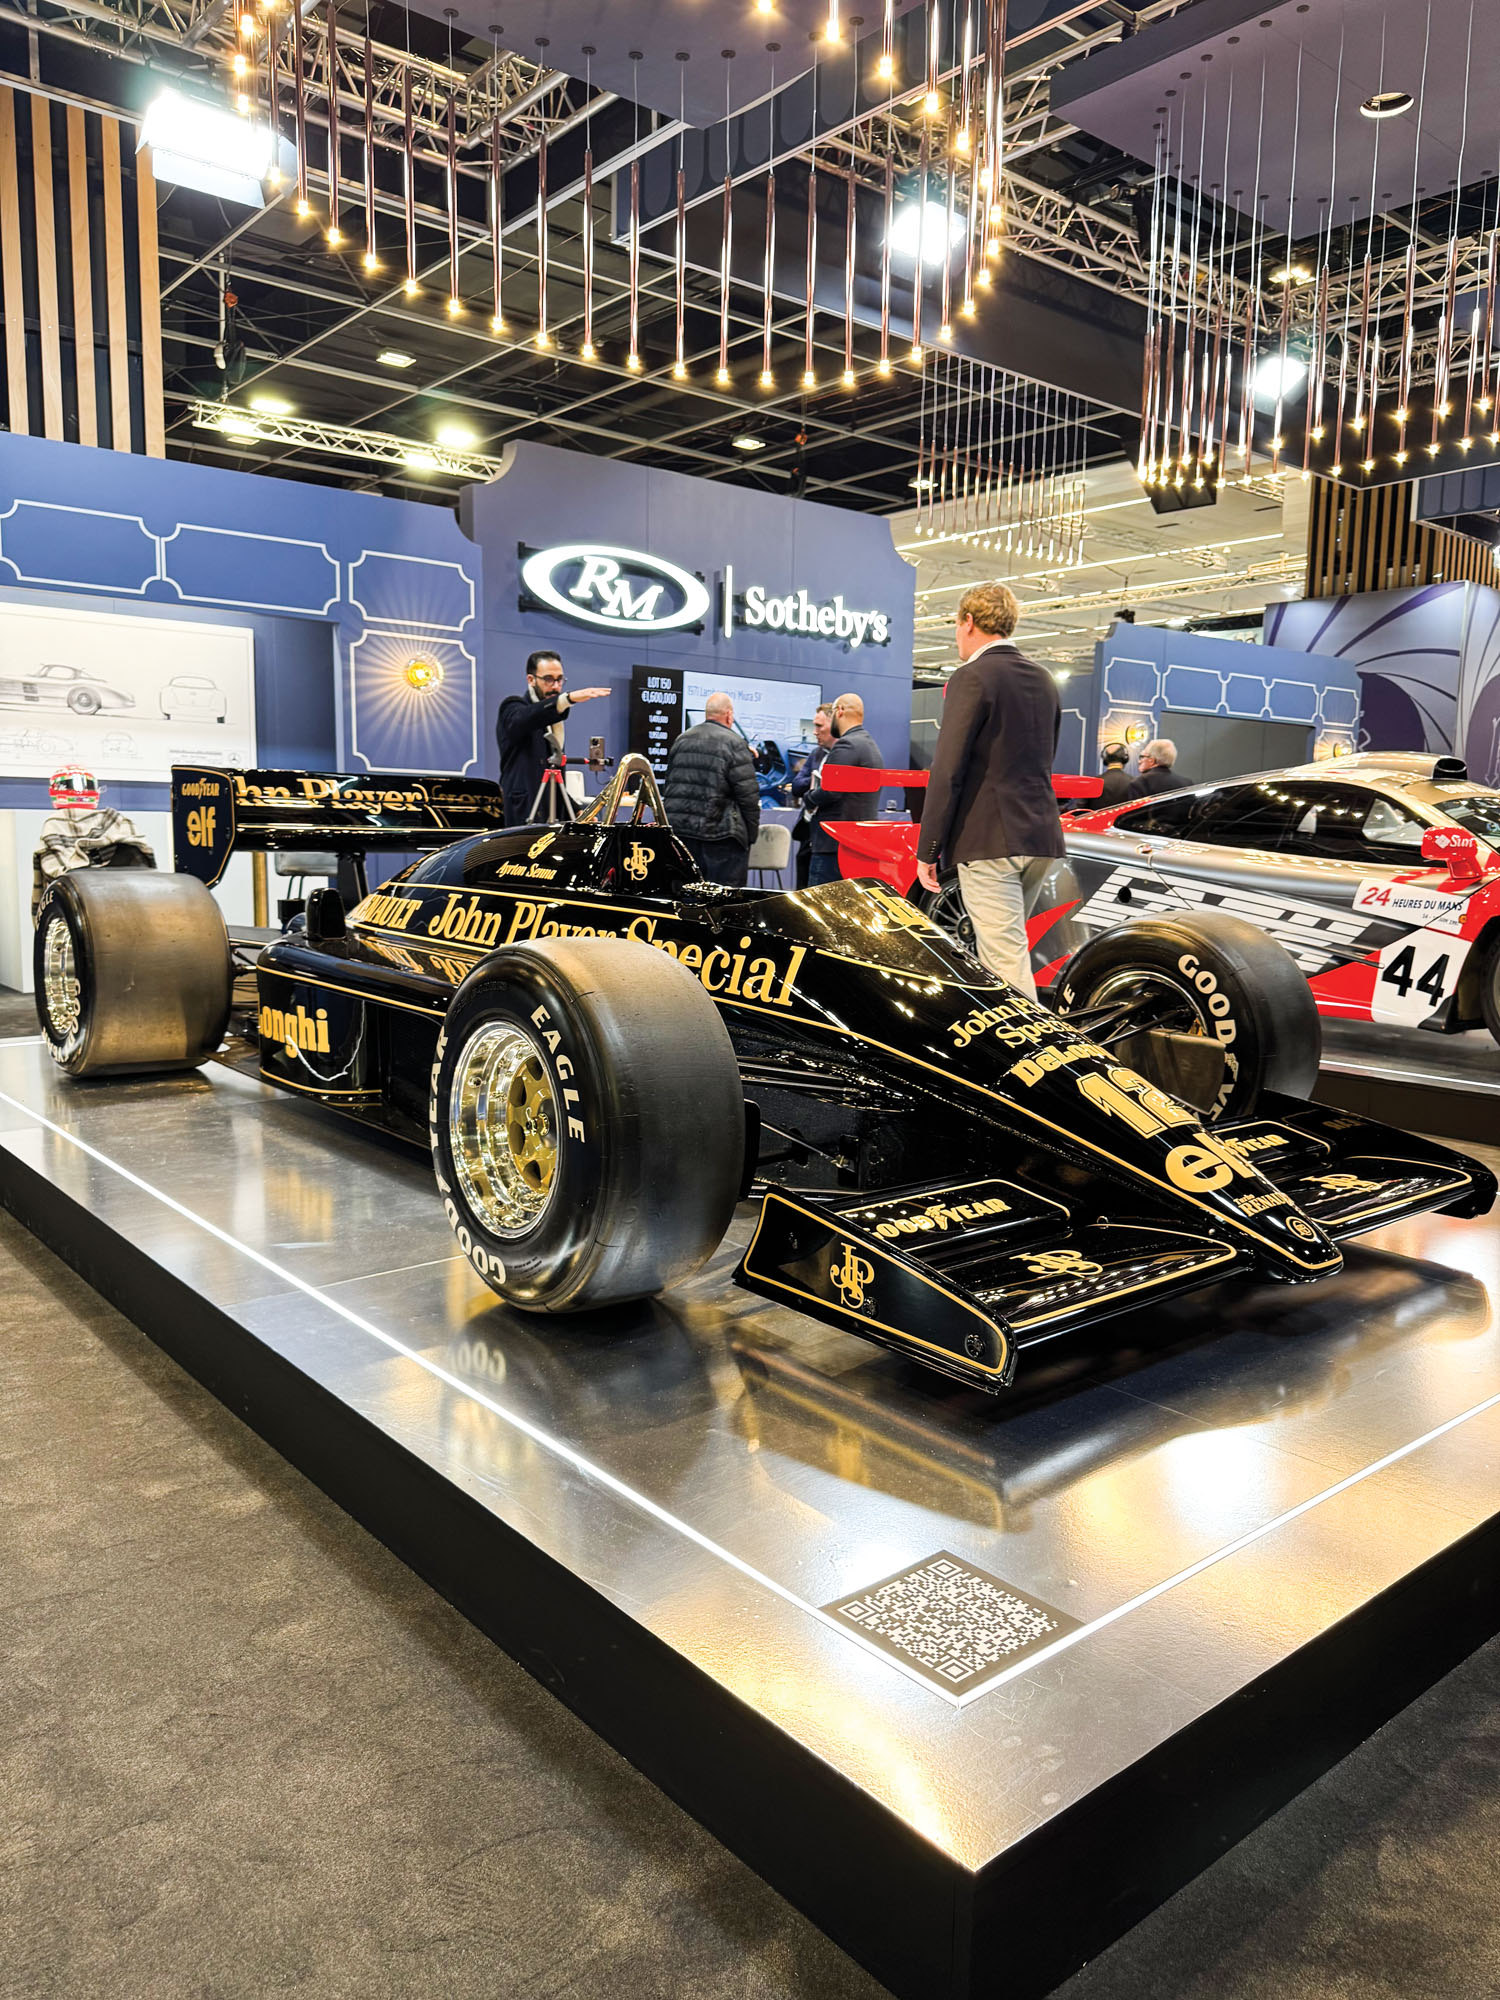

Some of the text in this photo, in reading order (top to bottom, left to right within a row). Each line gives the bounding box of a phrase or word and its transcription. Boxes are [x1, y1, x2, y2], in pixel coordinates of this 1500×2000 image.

[569, 555, 889, 648] RM Sotheby's
[181, 778, 220, 800] GOODYEAR
[233, 775, 291, 807] hn
[186, 806, 216, 848] elf
[495, 861, 558, 881] Ayrton Senna
[427, 892, 503, 947] John
[1360, 886, 1392, 907] 24
[1392, 898, 1422, 909] HEURES
[1423, 900, 1437, 910] DU
[1382, 945, 1450, 1007] 44
[947, 1003, 1020, 1048] John
[530, 1004, 585, 1144] EAGLE
[1076, 1067, 1201, 1139] 12
[1165, 1132, 1256, 1193] el
[872, 1198, 1012, 1241] OODYEAR
